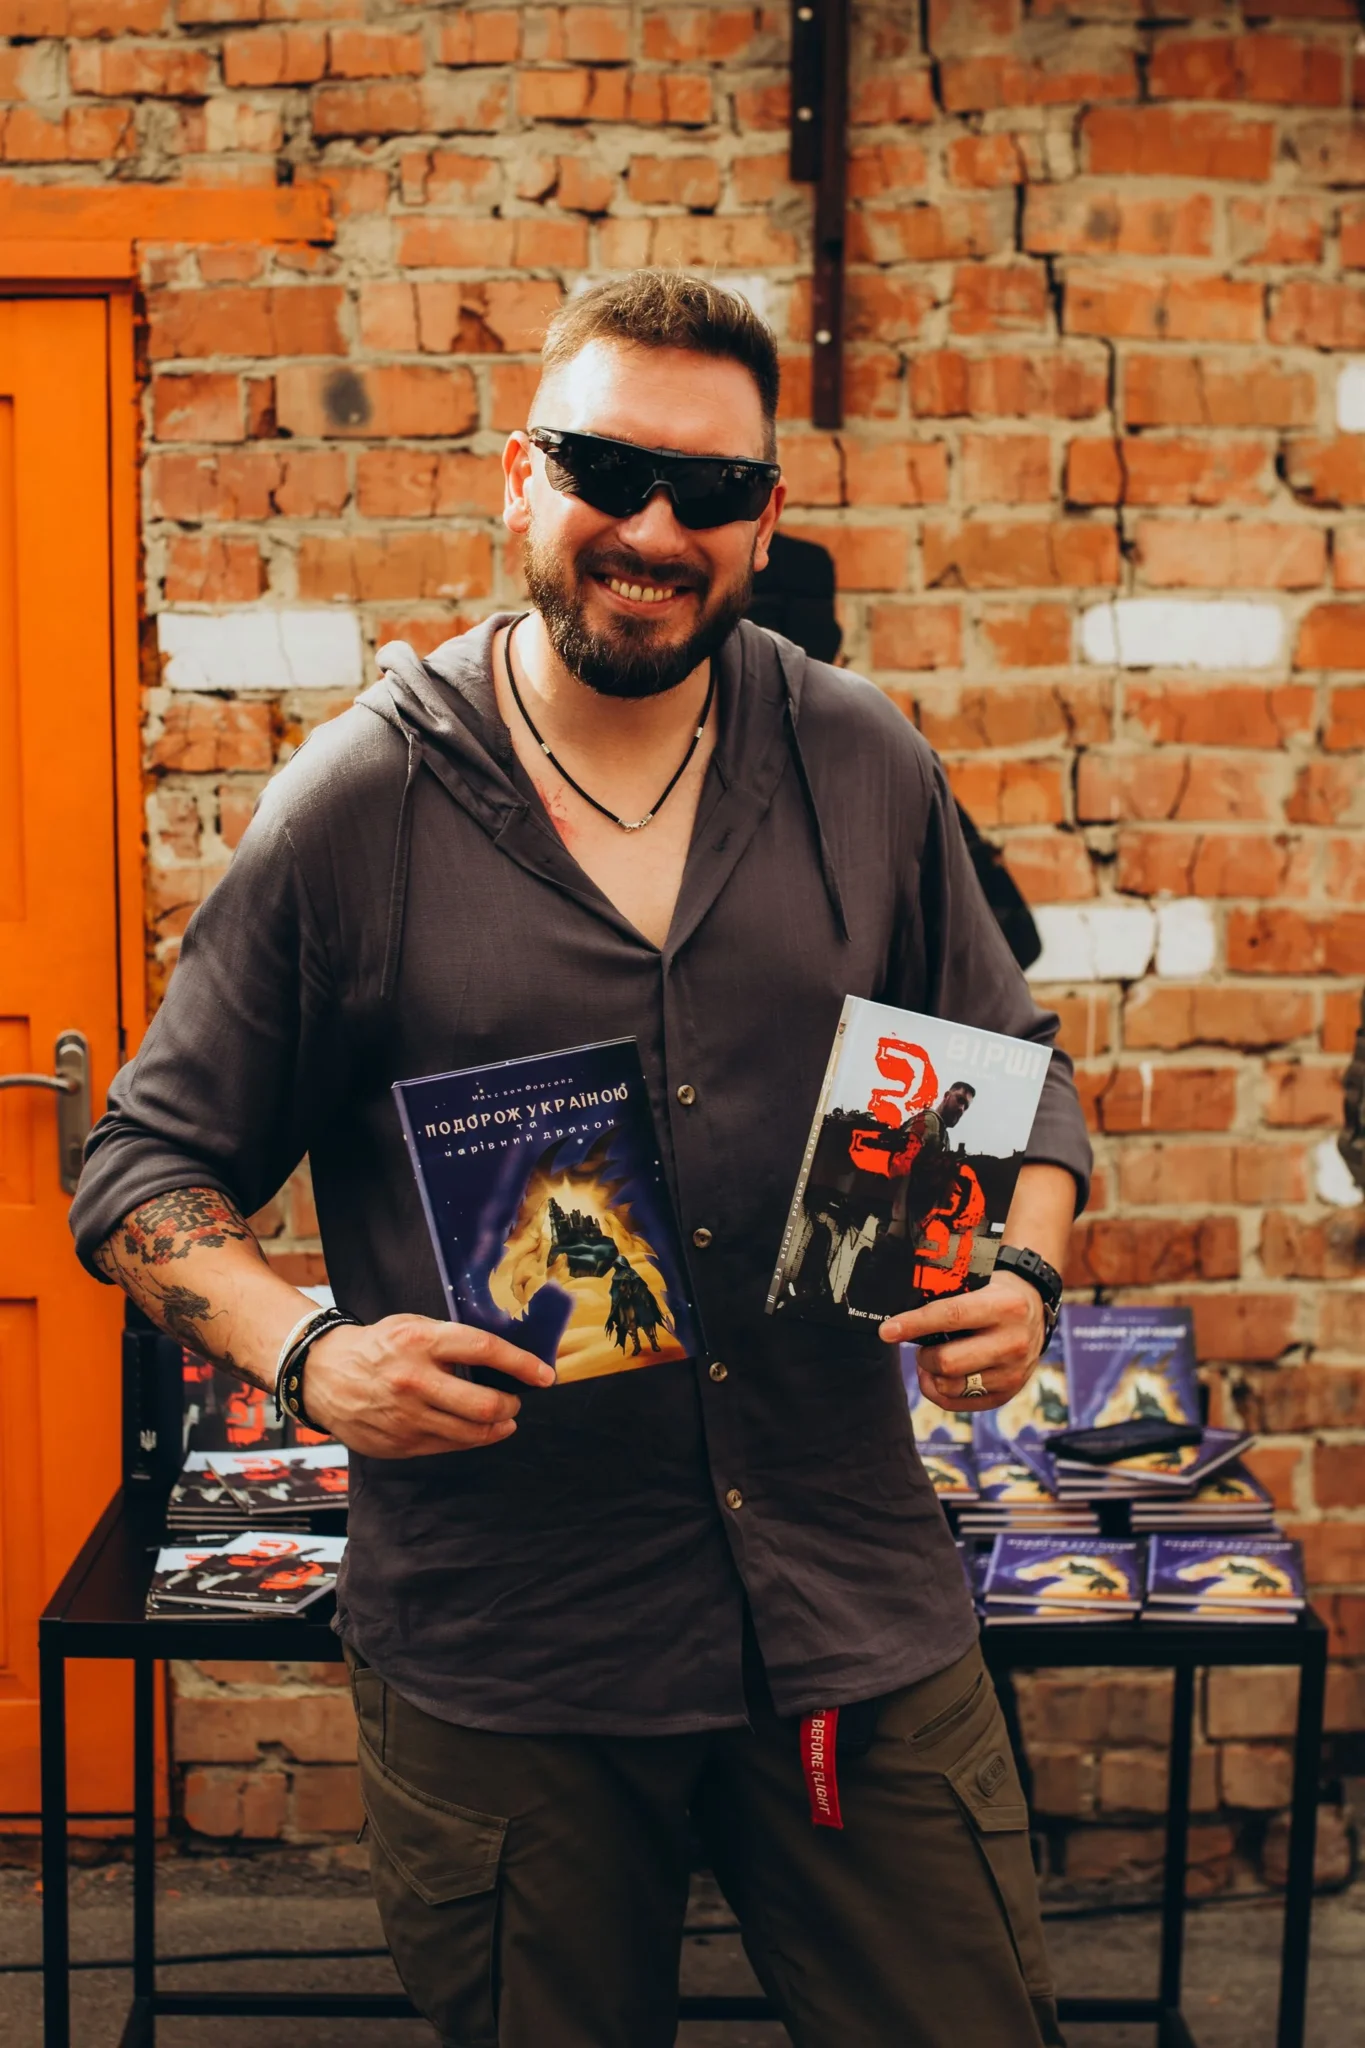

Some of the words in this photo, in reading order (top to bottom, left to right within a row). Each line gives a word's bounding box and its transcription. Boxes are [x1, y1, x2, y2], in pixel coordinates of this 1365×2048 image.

[946, 1032, 1043, 1080] ВІРШІ
[425, 1107, 522, 1138] ПОДОРОЖ
[526, 1085, 629, 1117] УКРАЇНОЮ
[472, 1092, 499, 1101] Макс
[444, 1132, 533, 1158] чарівний
[543, 1118, 616, 1141] дракон
[516, 1121, 538, 1131] та
[848, 1307, 868, 1318] Макс
[868, 1312, 883, 1321] ван
[810, 1719, 826, 1769] BEFORE
[811, 1770, 831, 1816] FLIGHT
